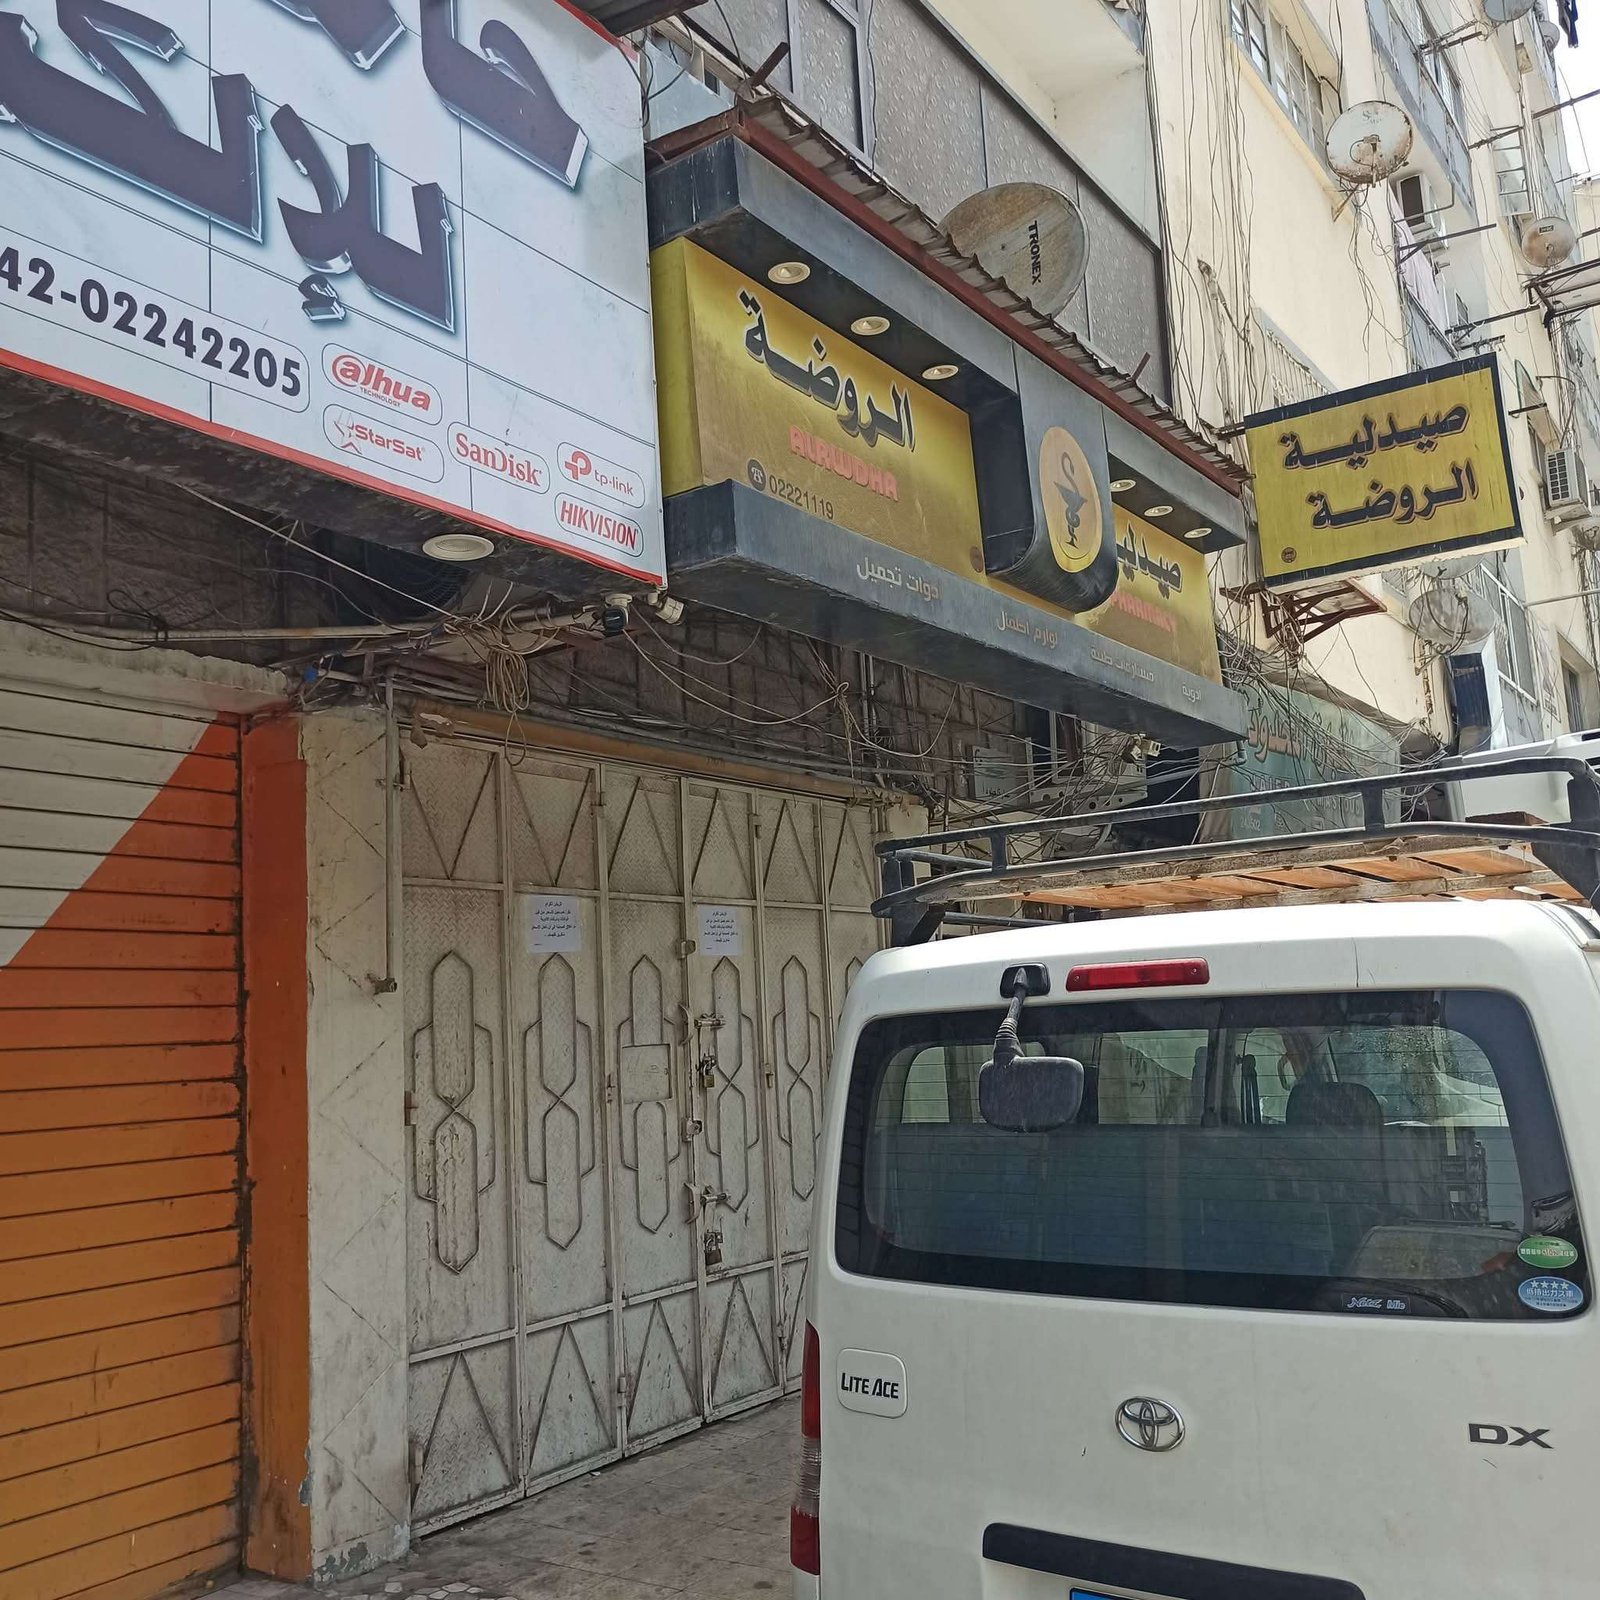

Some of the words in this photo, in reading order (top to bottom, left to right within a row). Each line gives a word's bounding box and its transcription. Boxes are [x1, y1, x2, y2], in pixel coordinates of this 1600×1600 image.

[1027, 220, 1041, 285] TRONEX
[737, 288, 915, 453] الروضة
[355, 423, 423, 461] StarSat
[455, 432, 541, 487] SanDisk
[1279, 402, 1471, 470] صيدلية
[594, 469, 635, 497] tp-link
[768, 475, 835, 520] 02221119
[1306, 457, 1479, 529] الروضة
[560, 500, 639, 551] HIKVISION
[856, 556, 903, 589] تجميل
[841, 1372, 870, 1394] LITE
[871, 1378, 899, 1399] ACE
[1468, 1423, 1554, 1449] DX
